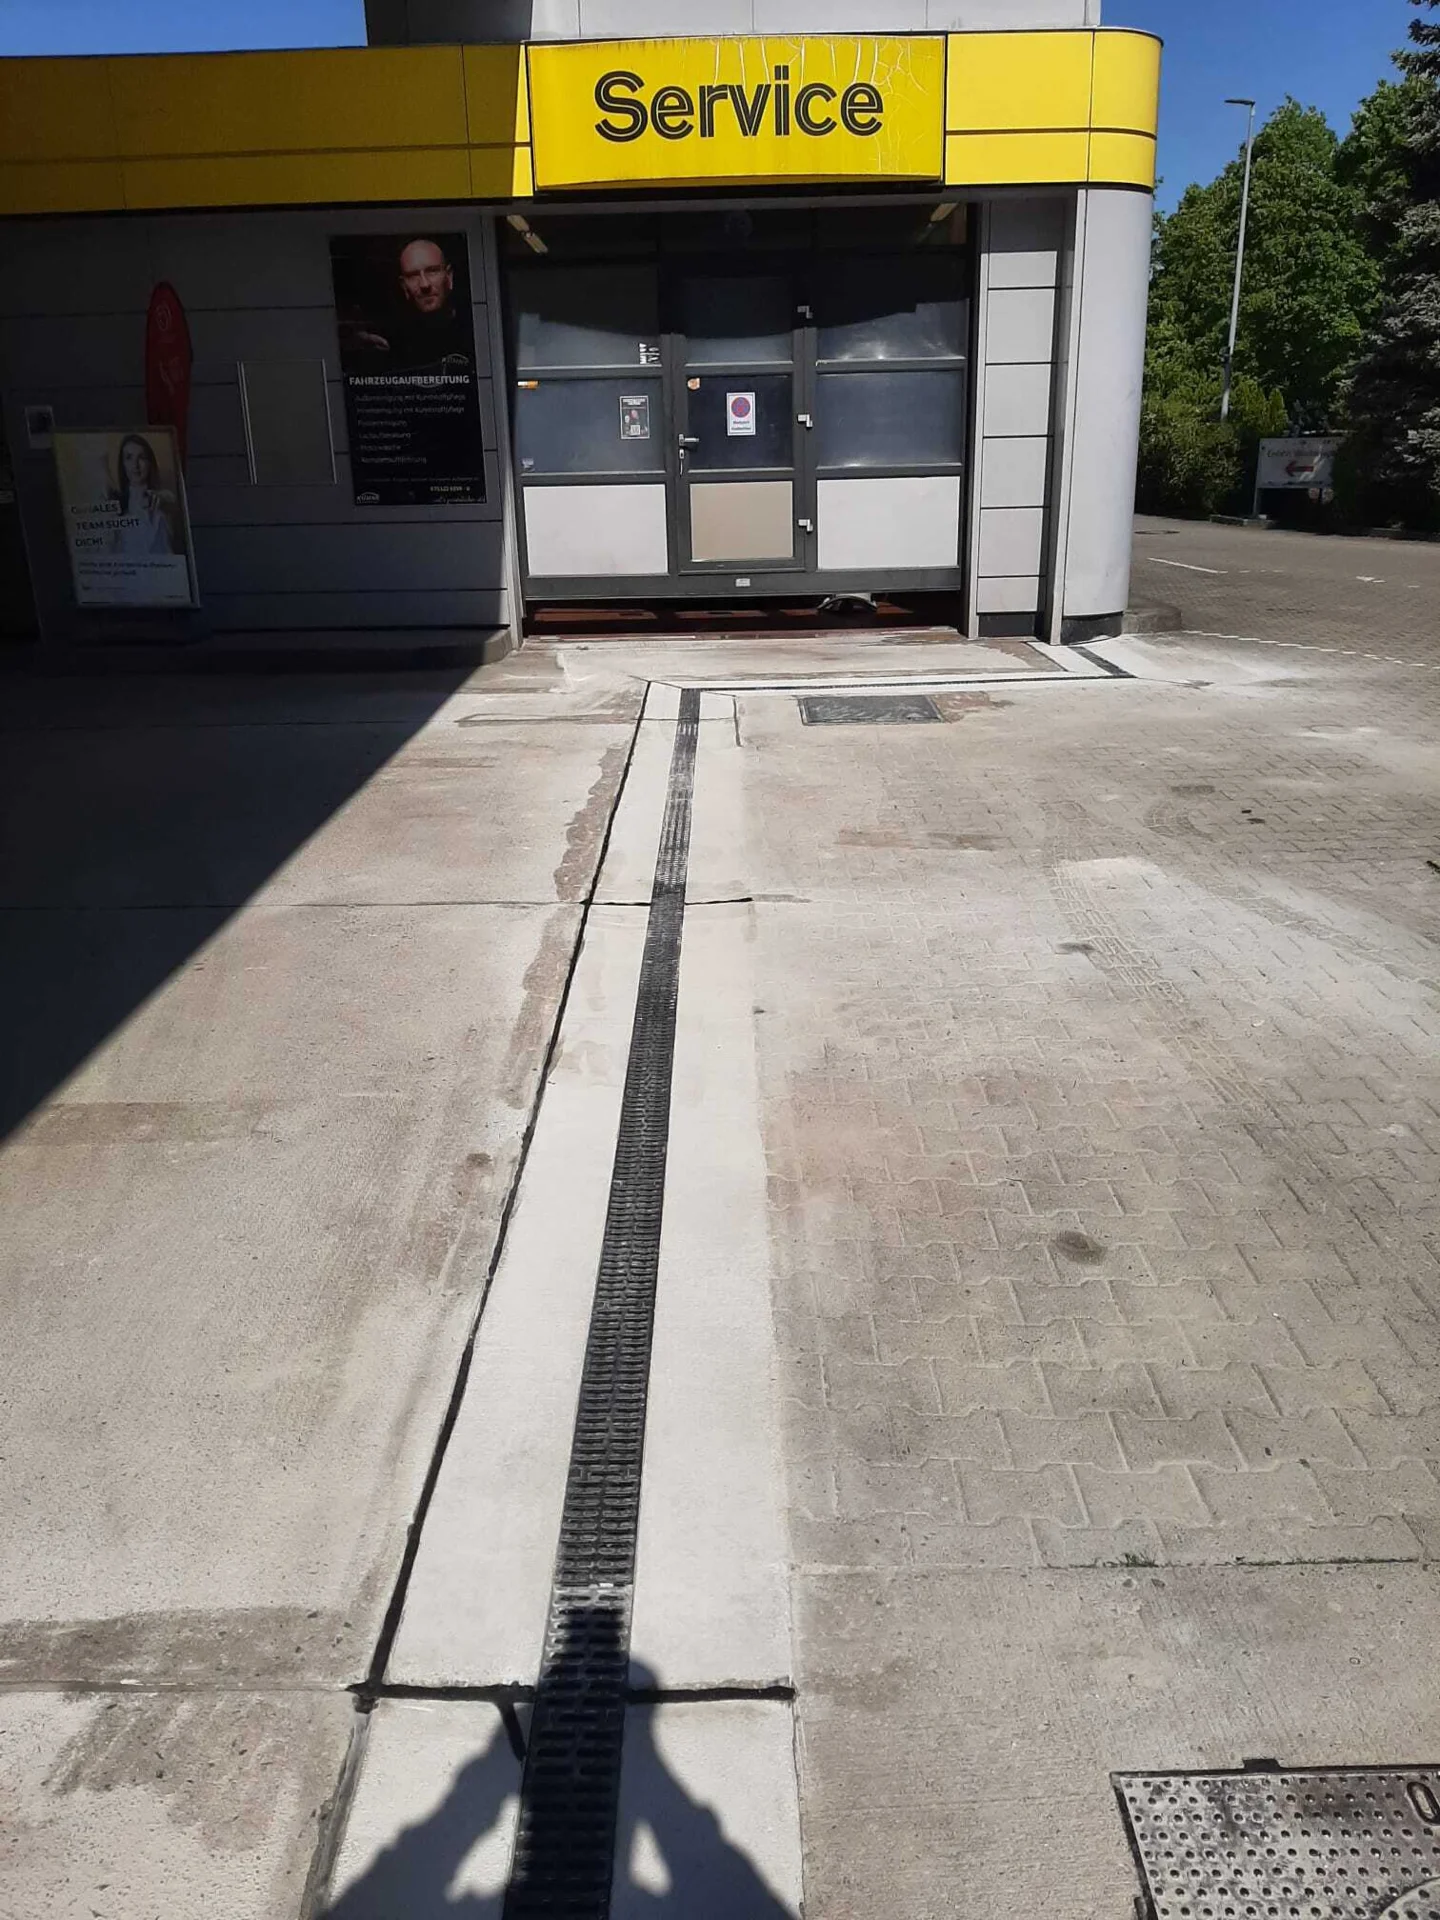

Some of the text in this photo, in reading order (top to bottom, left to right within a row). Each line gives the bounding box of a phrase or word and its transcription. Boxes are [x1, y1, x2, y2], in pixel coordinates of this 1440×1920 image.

[594, 64, 884, 143] Service
[349, 375, 470, 386] FAHRZEUGAUFBEREITUNG
[71, 503, 118, 513] GALES
[76, 518, 140, 531] TEAM SUCHT
